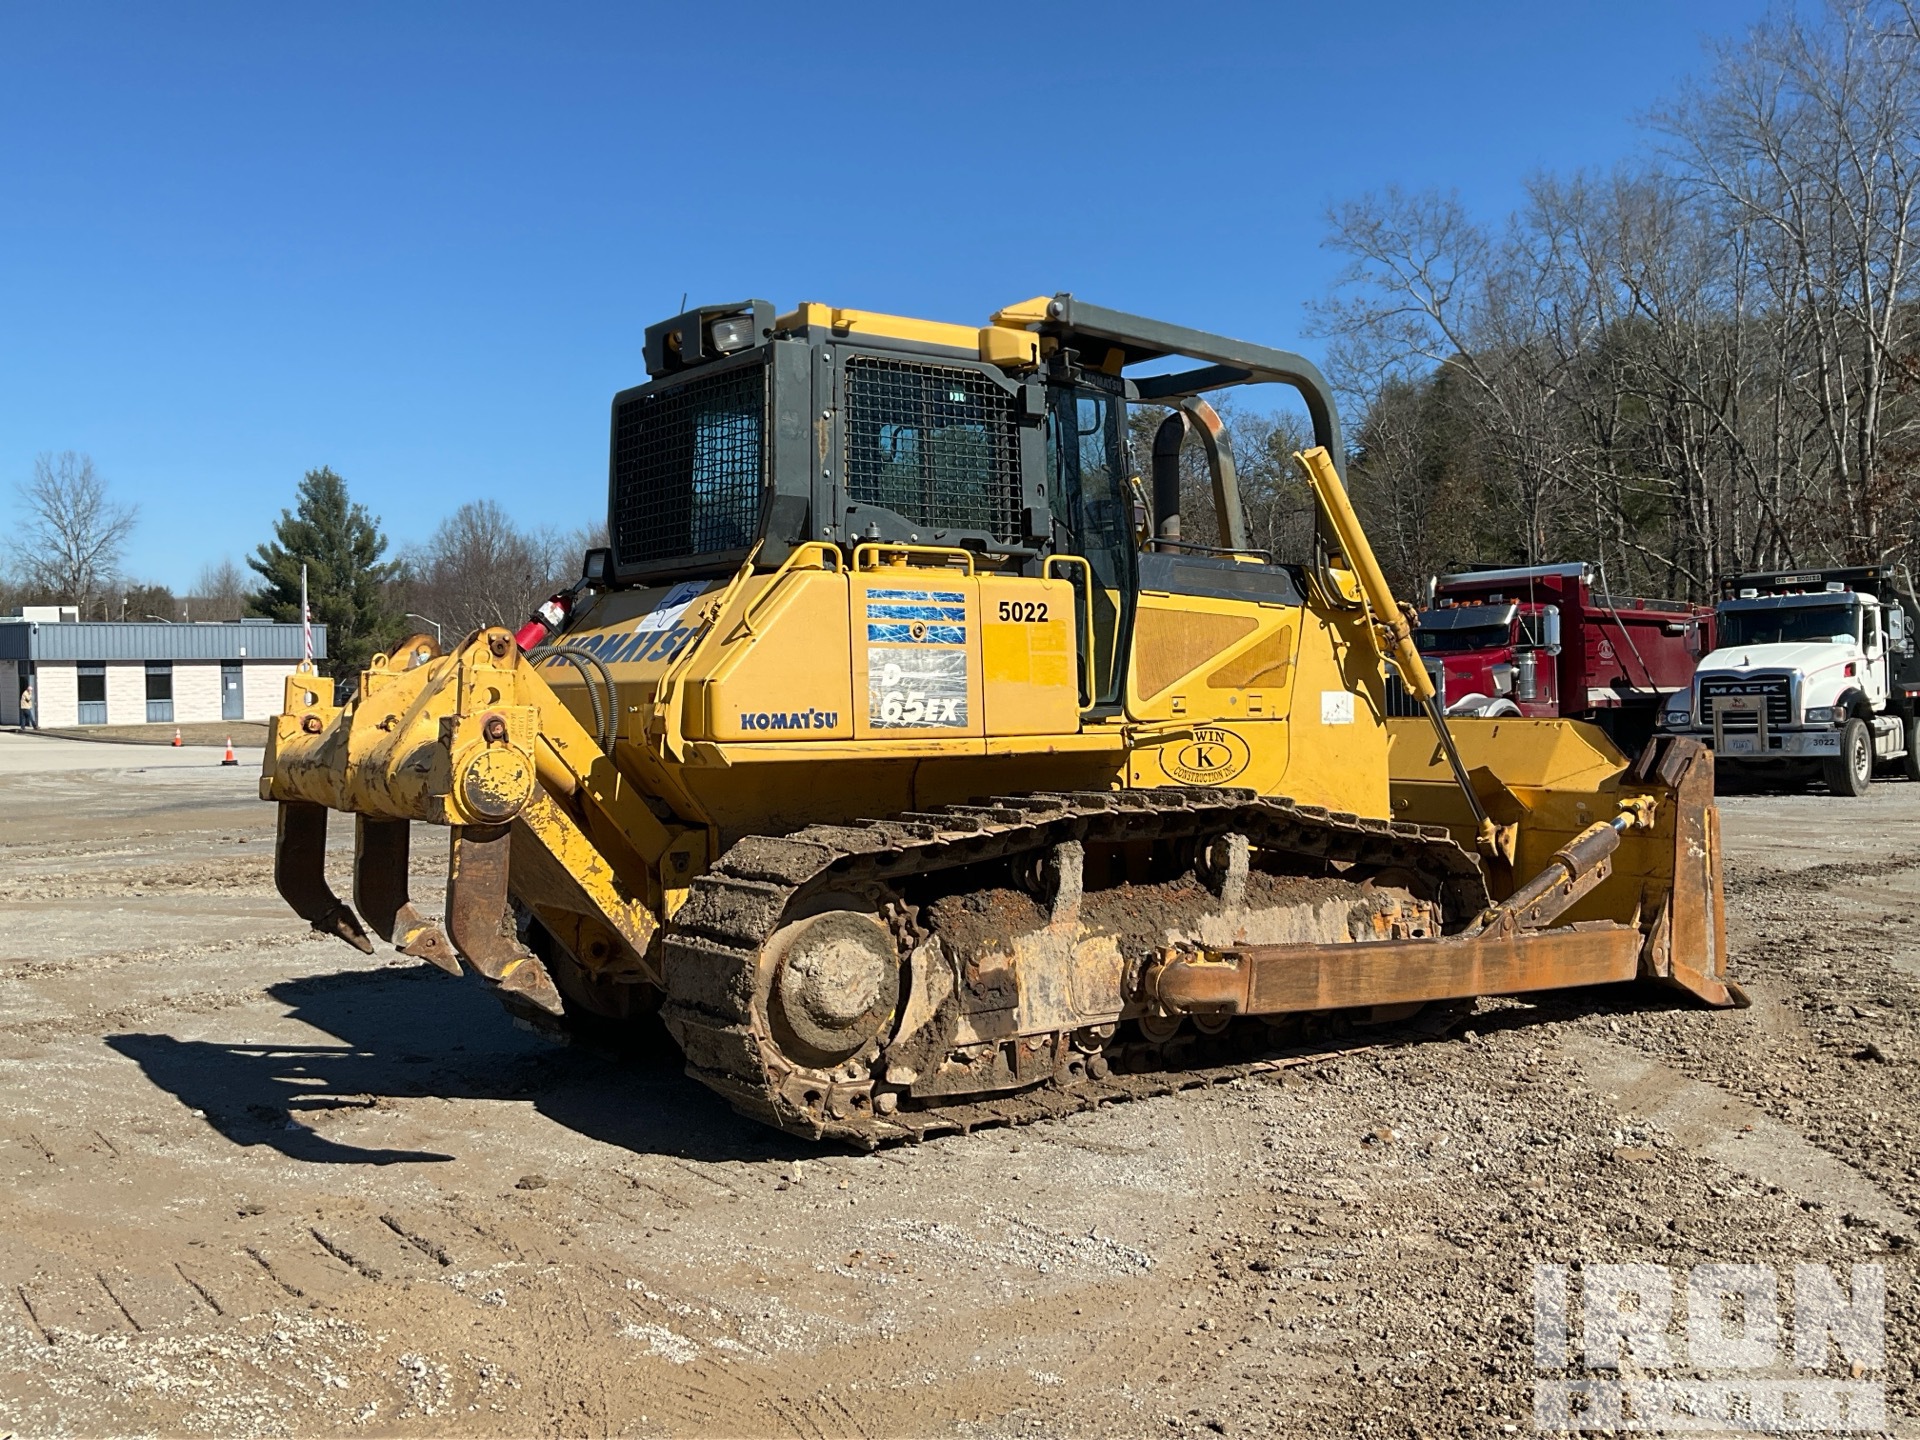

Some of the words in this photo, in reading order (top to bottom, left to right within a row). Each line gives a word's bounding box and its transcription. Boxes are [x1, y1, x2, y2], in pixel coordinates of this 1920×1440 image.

[998, 601, 1048, 622] 5022
[881, 663, 901, 686] D
[1709, 684, 1779, 694] MACK
[881, 691, 961, 723] 65EX
[740, 707, 838, 730] KOMATSU
[1195, 731, 1225, 742] WIN
[1813, 738, 1835, 746] 3022
[1196, 747, 1214, 767] K
[1173, 767, 1223, 782] CONSTRUCTION
